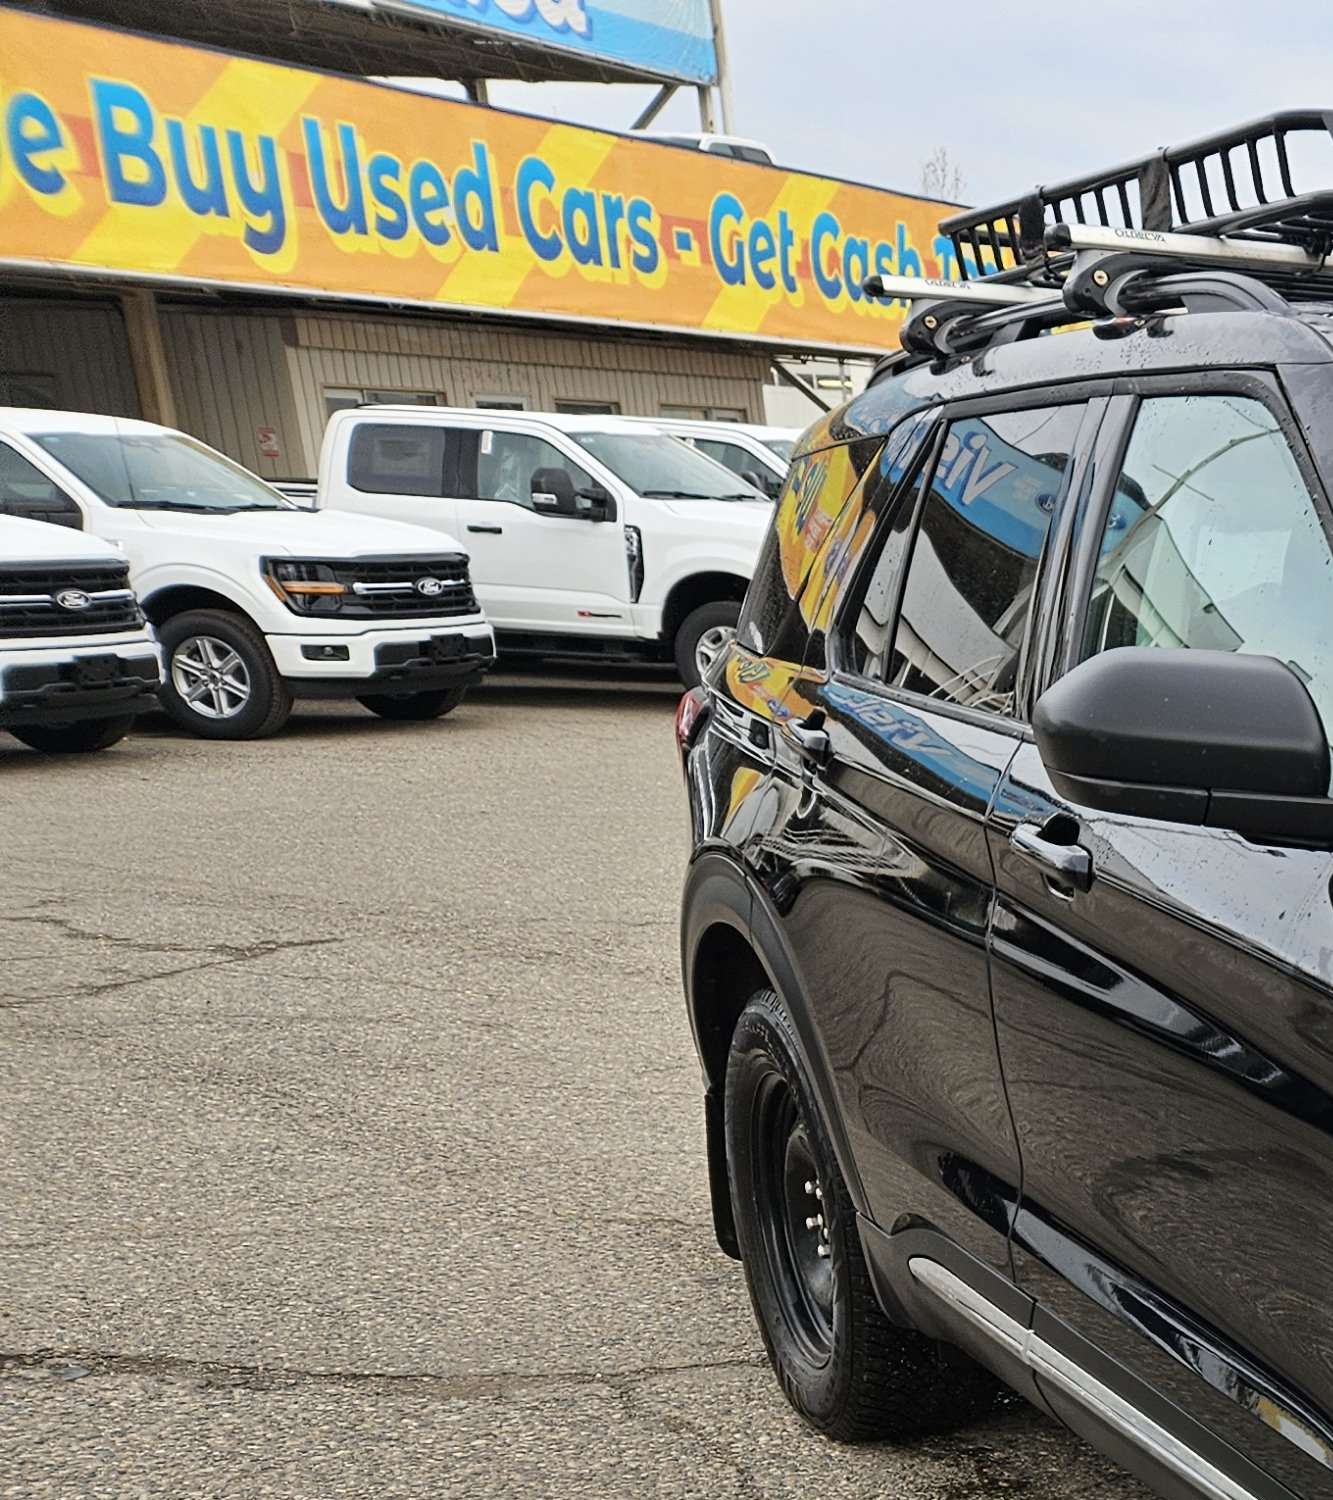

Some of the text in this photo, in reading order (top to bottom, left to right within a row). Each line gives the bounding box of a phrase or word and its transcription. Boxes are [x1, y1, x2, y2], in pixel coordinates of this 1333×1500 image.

[89, 77, 286, 255] Buy
[302, 116, 499, 253] Used
[516, 156, 659, 274] Cars
[711, 194, 797, 293] Get
